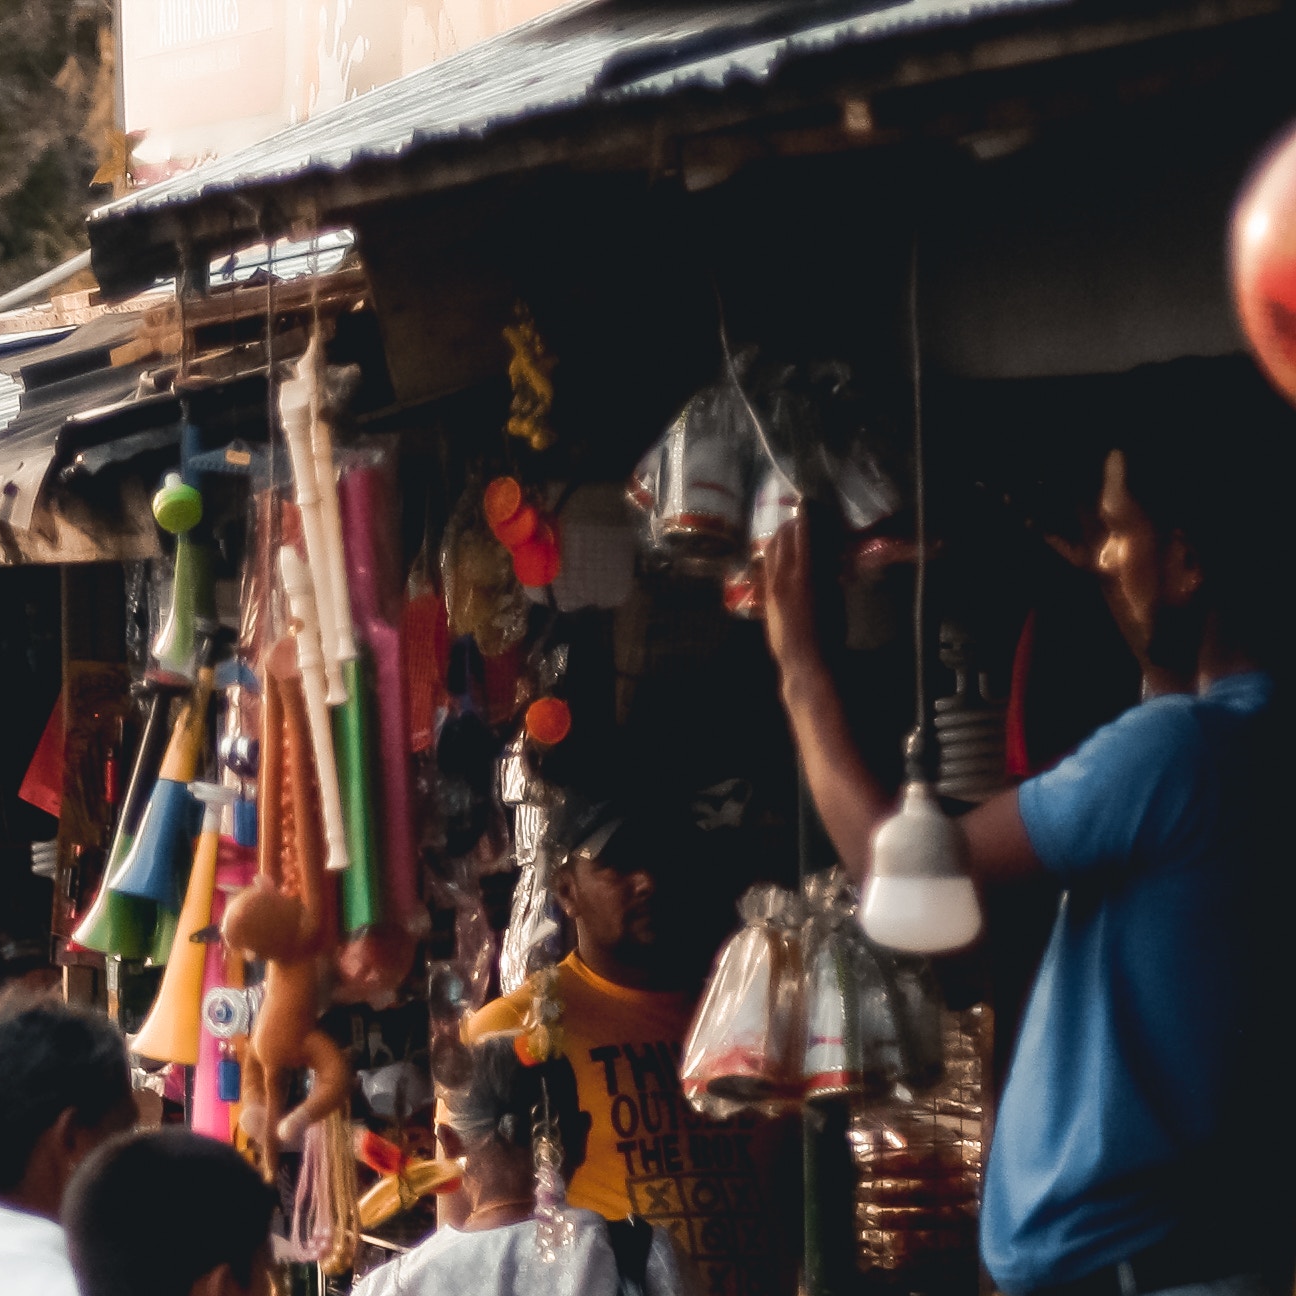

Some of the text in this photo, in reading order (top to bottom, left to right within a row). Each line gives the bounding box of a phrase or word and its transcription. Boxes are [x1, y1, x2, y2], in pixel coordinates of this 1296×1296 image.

[589, 1041, 680, 1096] THI
[616, 1132, 755, 1175] THE BOX
